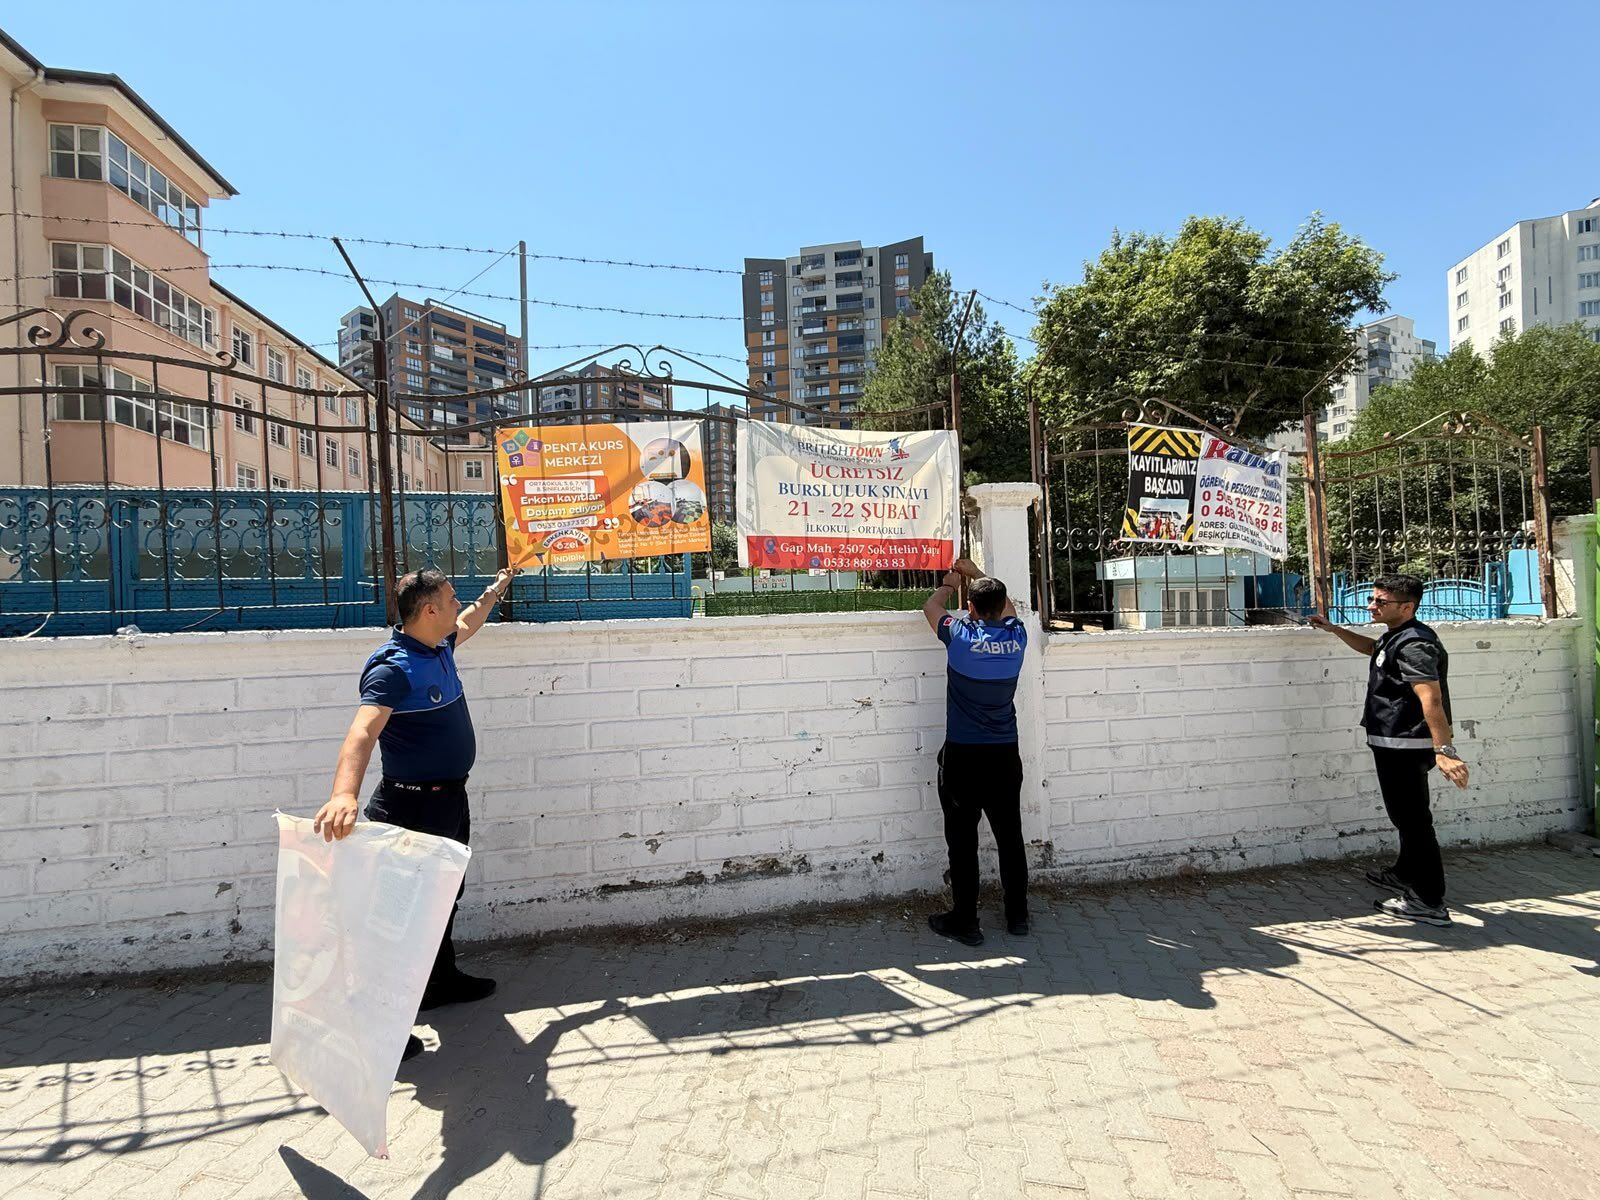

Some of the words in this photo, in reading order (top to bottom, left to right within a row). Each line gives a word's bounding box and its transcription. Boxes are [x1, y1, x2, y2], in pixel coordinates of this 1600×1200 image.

[545, 453, 602, 468] MERKEZİ
[811, 460, 904, 481] ÜCRETSİZ
[778, 482, 878, 498] BURSLULUK
[882, 485, 929, 500] SINAVI
[1144, 476, 1184, 498] BAŞLADI
[521, 496, 554, 505] Erken
[557, 492, 602, 504] kayıtlar
[1202, 490, 1211, 501] 0
[1235, 497, 1255, 512] 237
[1257, 502, 1270, 516] 72
[526, 508, 566, 517] Devam
[787, 500, 810, 516] 21
[831, 502, 855, 518] 22
[861, 502, 921, 522] ŞUBAT
[1201, 505, 1210, 517] 0
[1215, 505, 1235, 520] 488
[1255, 517, 1268, 531] 89
[806, 522, 850, 533] İLKOKUL
[858, 525, 906, 535] ORTAOKUL
[1199, 521, 1227, 529] ADRES:
[1198, 529, 1240, 540] BEŞİKÇİLER
[556, 540, 579, 549] özel
[780, 542, 803, 554] Gap
[807, 543, 835, 553] Mah.
[839, 544, 865, 554] 2507
[889, 544, 918, 555] Helin
[553, 554, 586, 563] İNDİRİM
[823, 557, 850, 568] 0533
[853, 557, 872, 568] 889
[875, 557, 889, 568] 83
[891, 557, 905, 568] 83
[970, 639, 1021, 654] ZABITA
[394, 782, 421, 791] ZAITA
